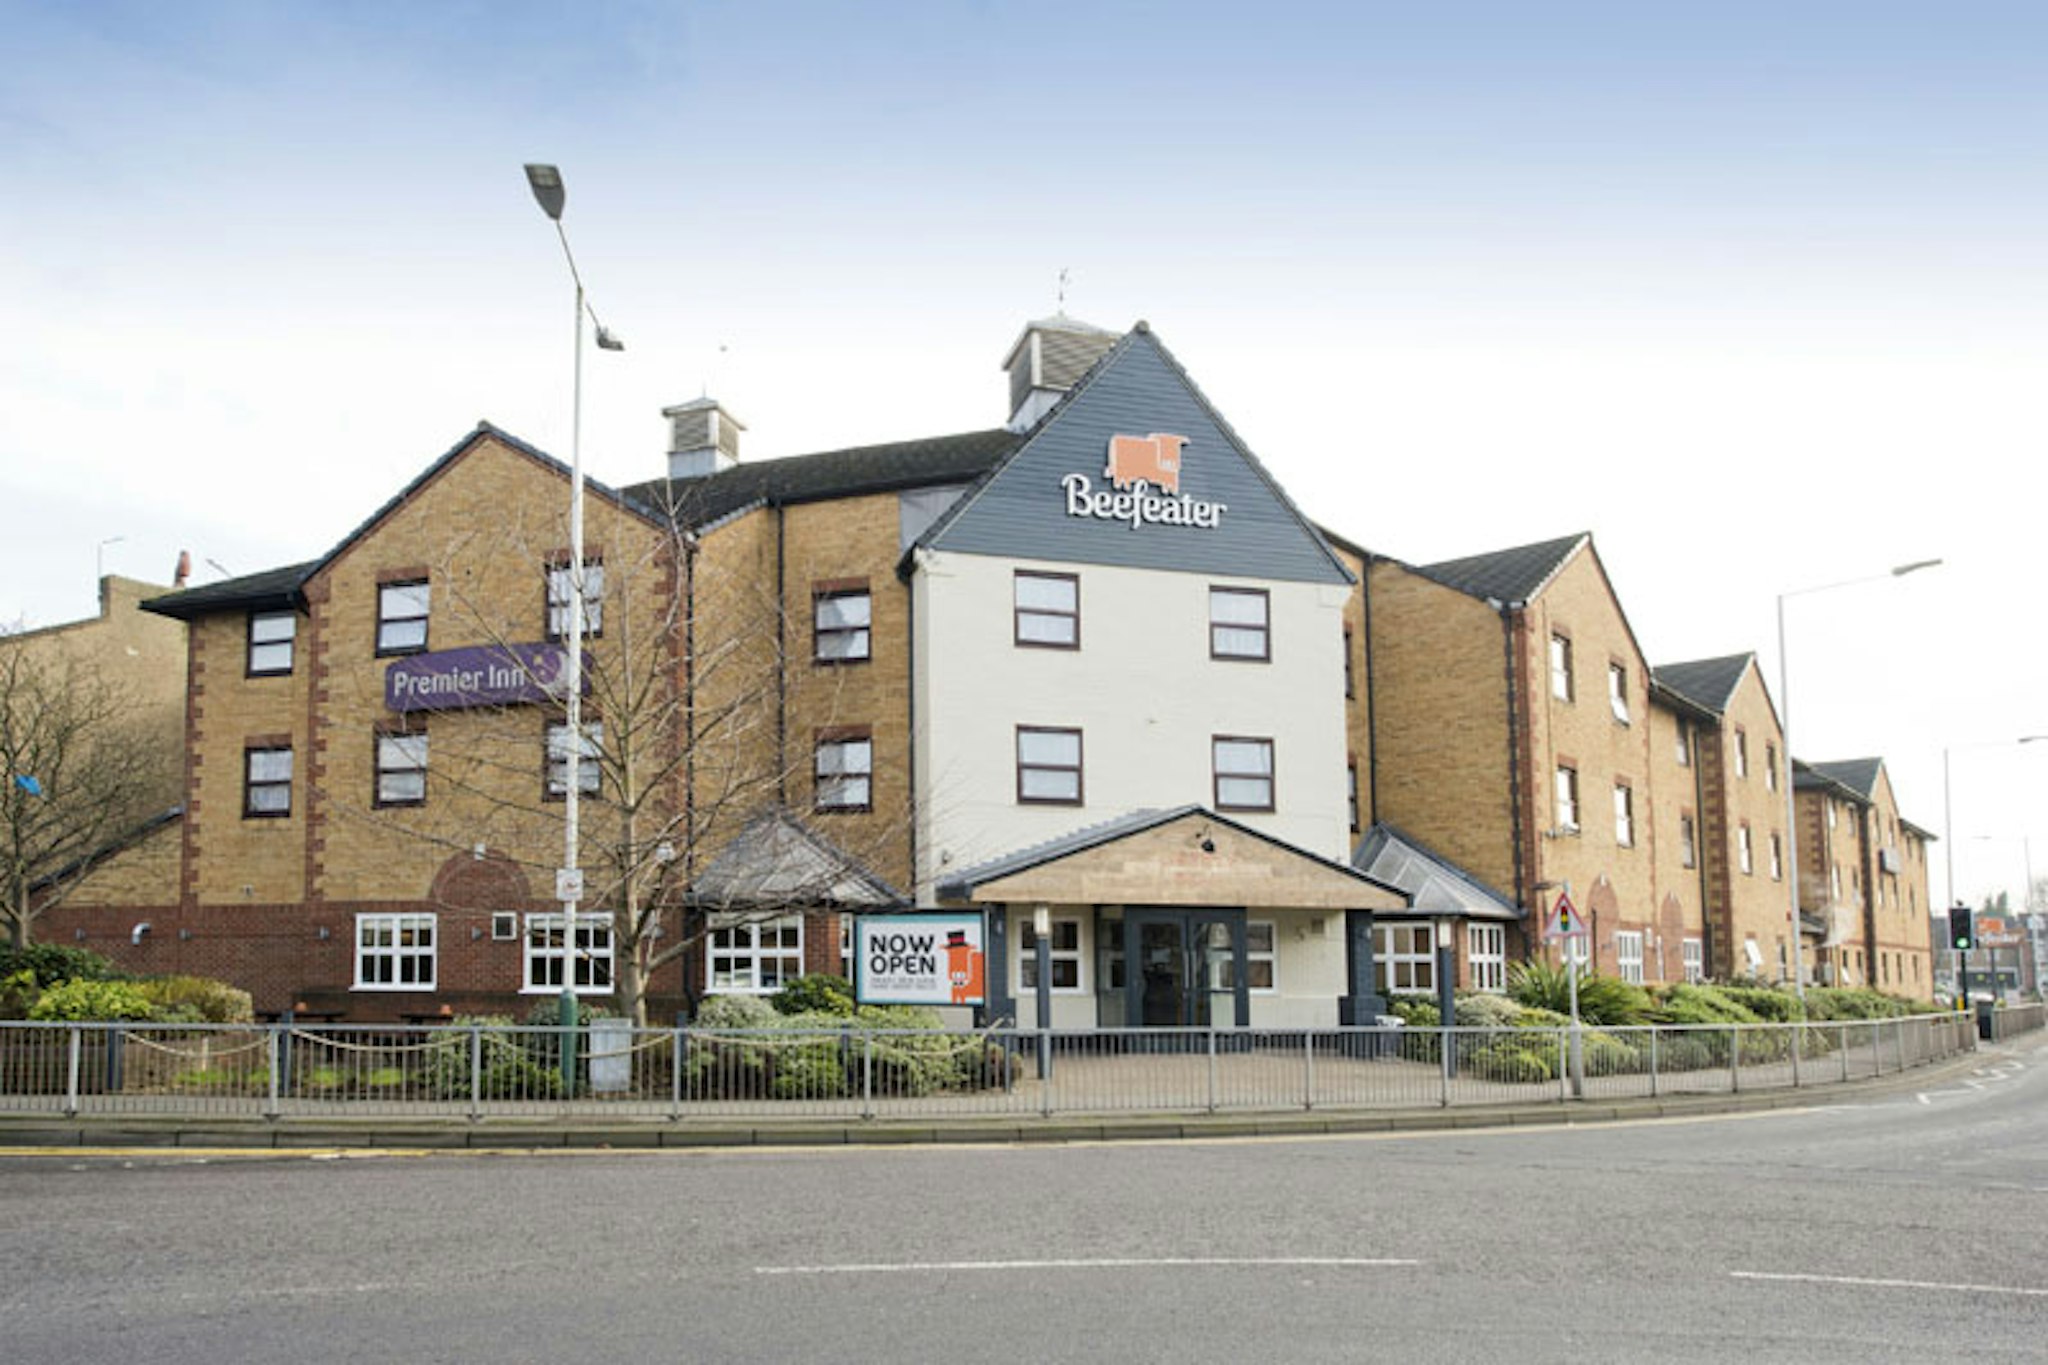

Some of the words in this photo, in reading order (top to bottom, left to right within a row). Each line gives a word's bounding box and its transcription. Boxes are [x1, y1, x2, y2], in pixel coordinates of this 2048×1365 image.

[1061, 473, 1228, 530] Beefeater
[393, 667, 484, 698] Premier
[488, 664, 525, 689] Inn
[870, 934, 935, 954] NOW
[870, 955, 936, 975] OPEN
